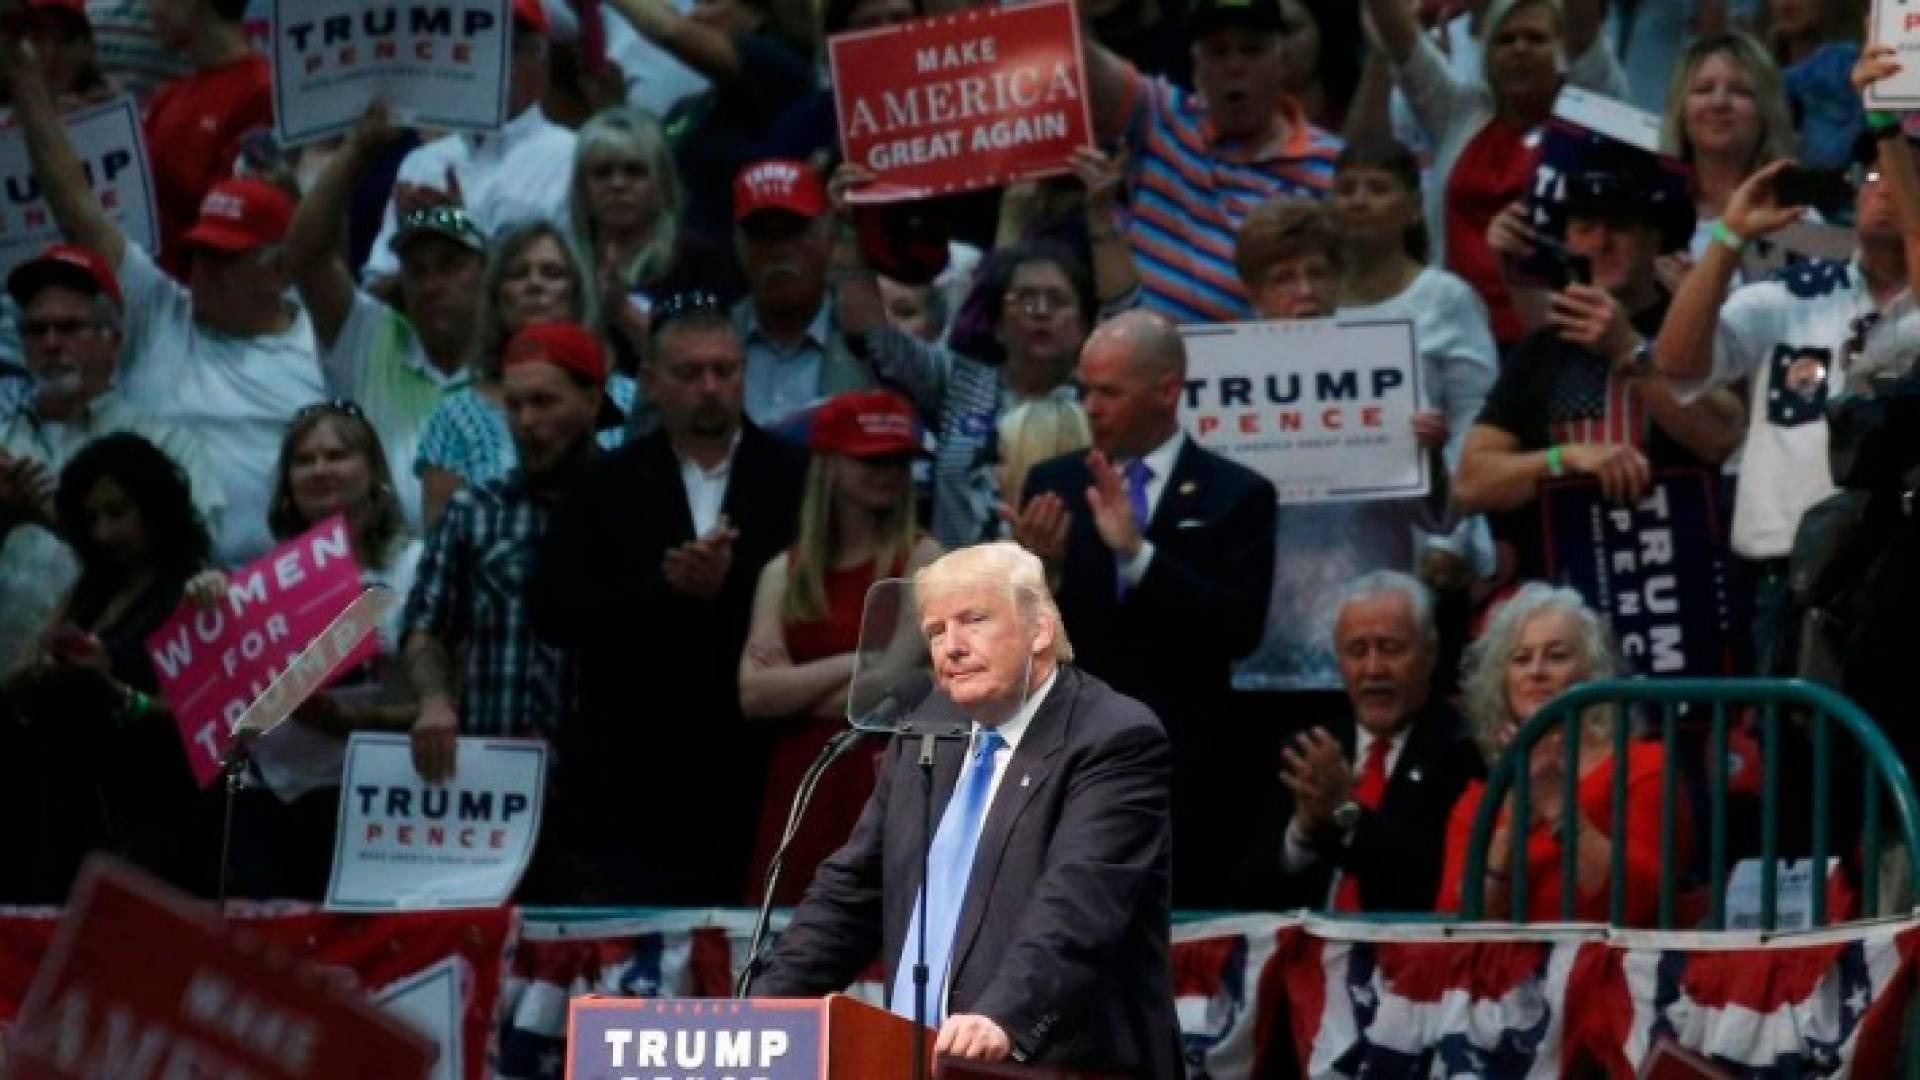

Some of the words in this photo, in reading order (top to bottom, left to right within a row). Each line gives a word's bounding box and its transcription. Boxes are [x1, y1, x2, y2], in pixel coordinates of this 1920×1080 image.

[287, 7, 495, 52] TRUMP
[305, 41, 472, 74] PENCE
[917, 36, 997, 74] MAKE
[850, 61, 1078, 137] AMERICA
[868, 130, 962, 171] GREAT
[971, 112, 1067, 151] AGAIN
[1183, 368, 1404, 409] TRUMP
[1199, 407, 1383, 437] PENCE
[153, 523, 349, 679] WOMEN
[1608, 509, 1647, 681] PENC
[1638, 485, 1686, 716] TRUM
[222, 613, 290, 678] FOR
[356, 785, 528, 823] TRUMP
[366, 824, 507, 850] PENCE
[604, 1028, 789, 1070] TRUMP
